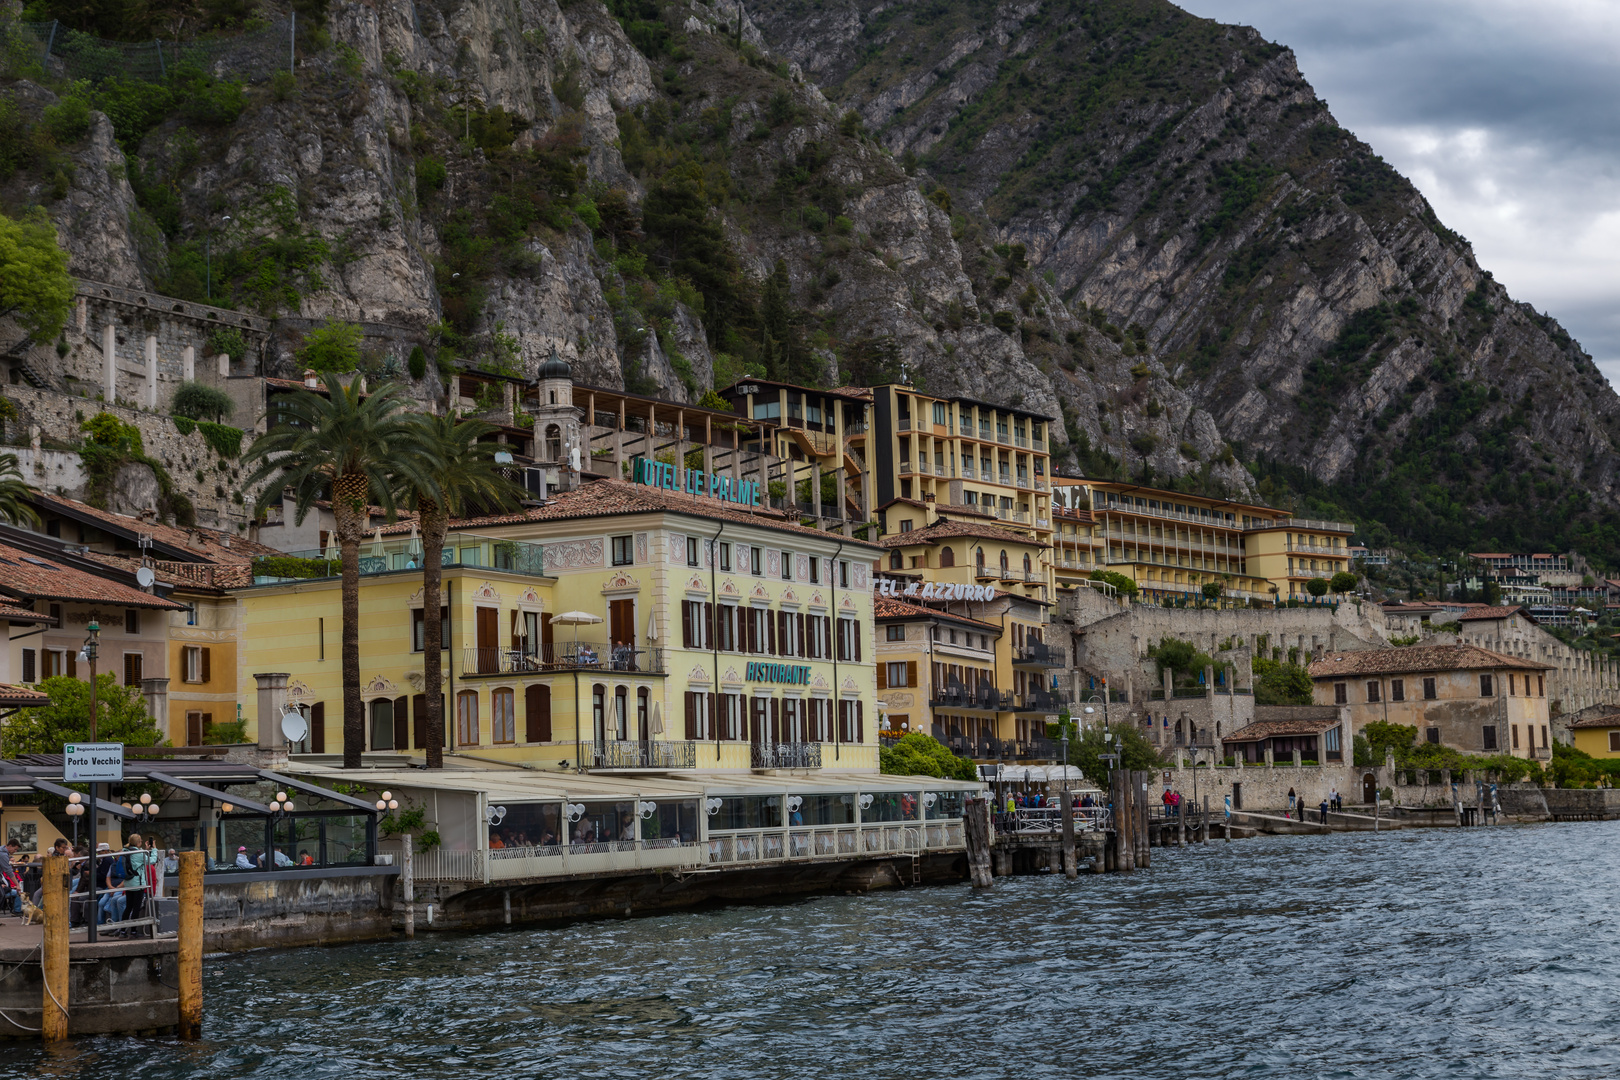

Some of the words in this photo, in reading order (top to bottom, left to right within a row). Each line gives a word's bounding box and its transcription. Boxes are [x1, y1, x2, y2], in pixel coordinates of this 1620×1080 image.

[633, 456, 680, 491] HOTEL
[685, 468, 704, 495] LE
[708, 472, 760, 506] PALME
[921, 582, 995, 601] AZZURRO
[745, 661, 812, 685] RISTORANTE
[67, 757, 88, 765] Porto
[91, 756, 121, 765] Vecchio
